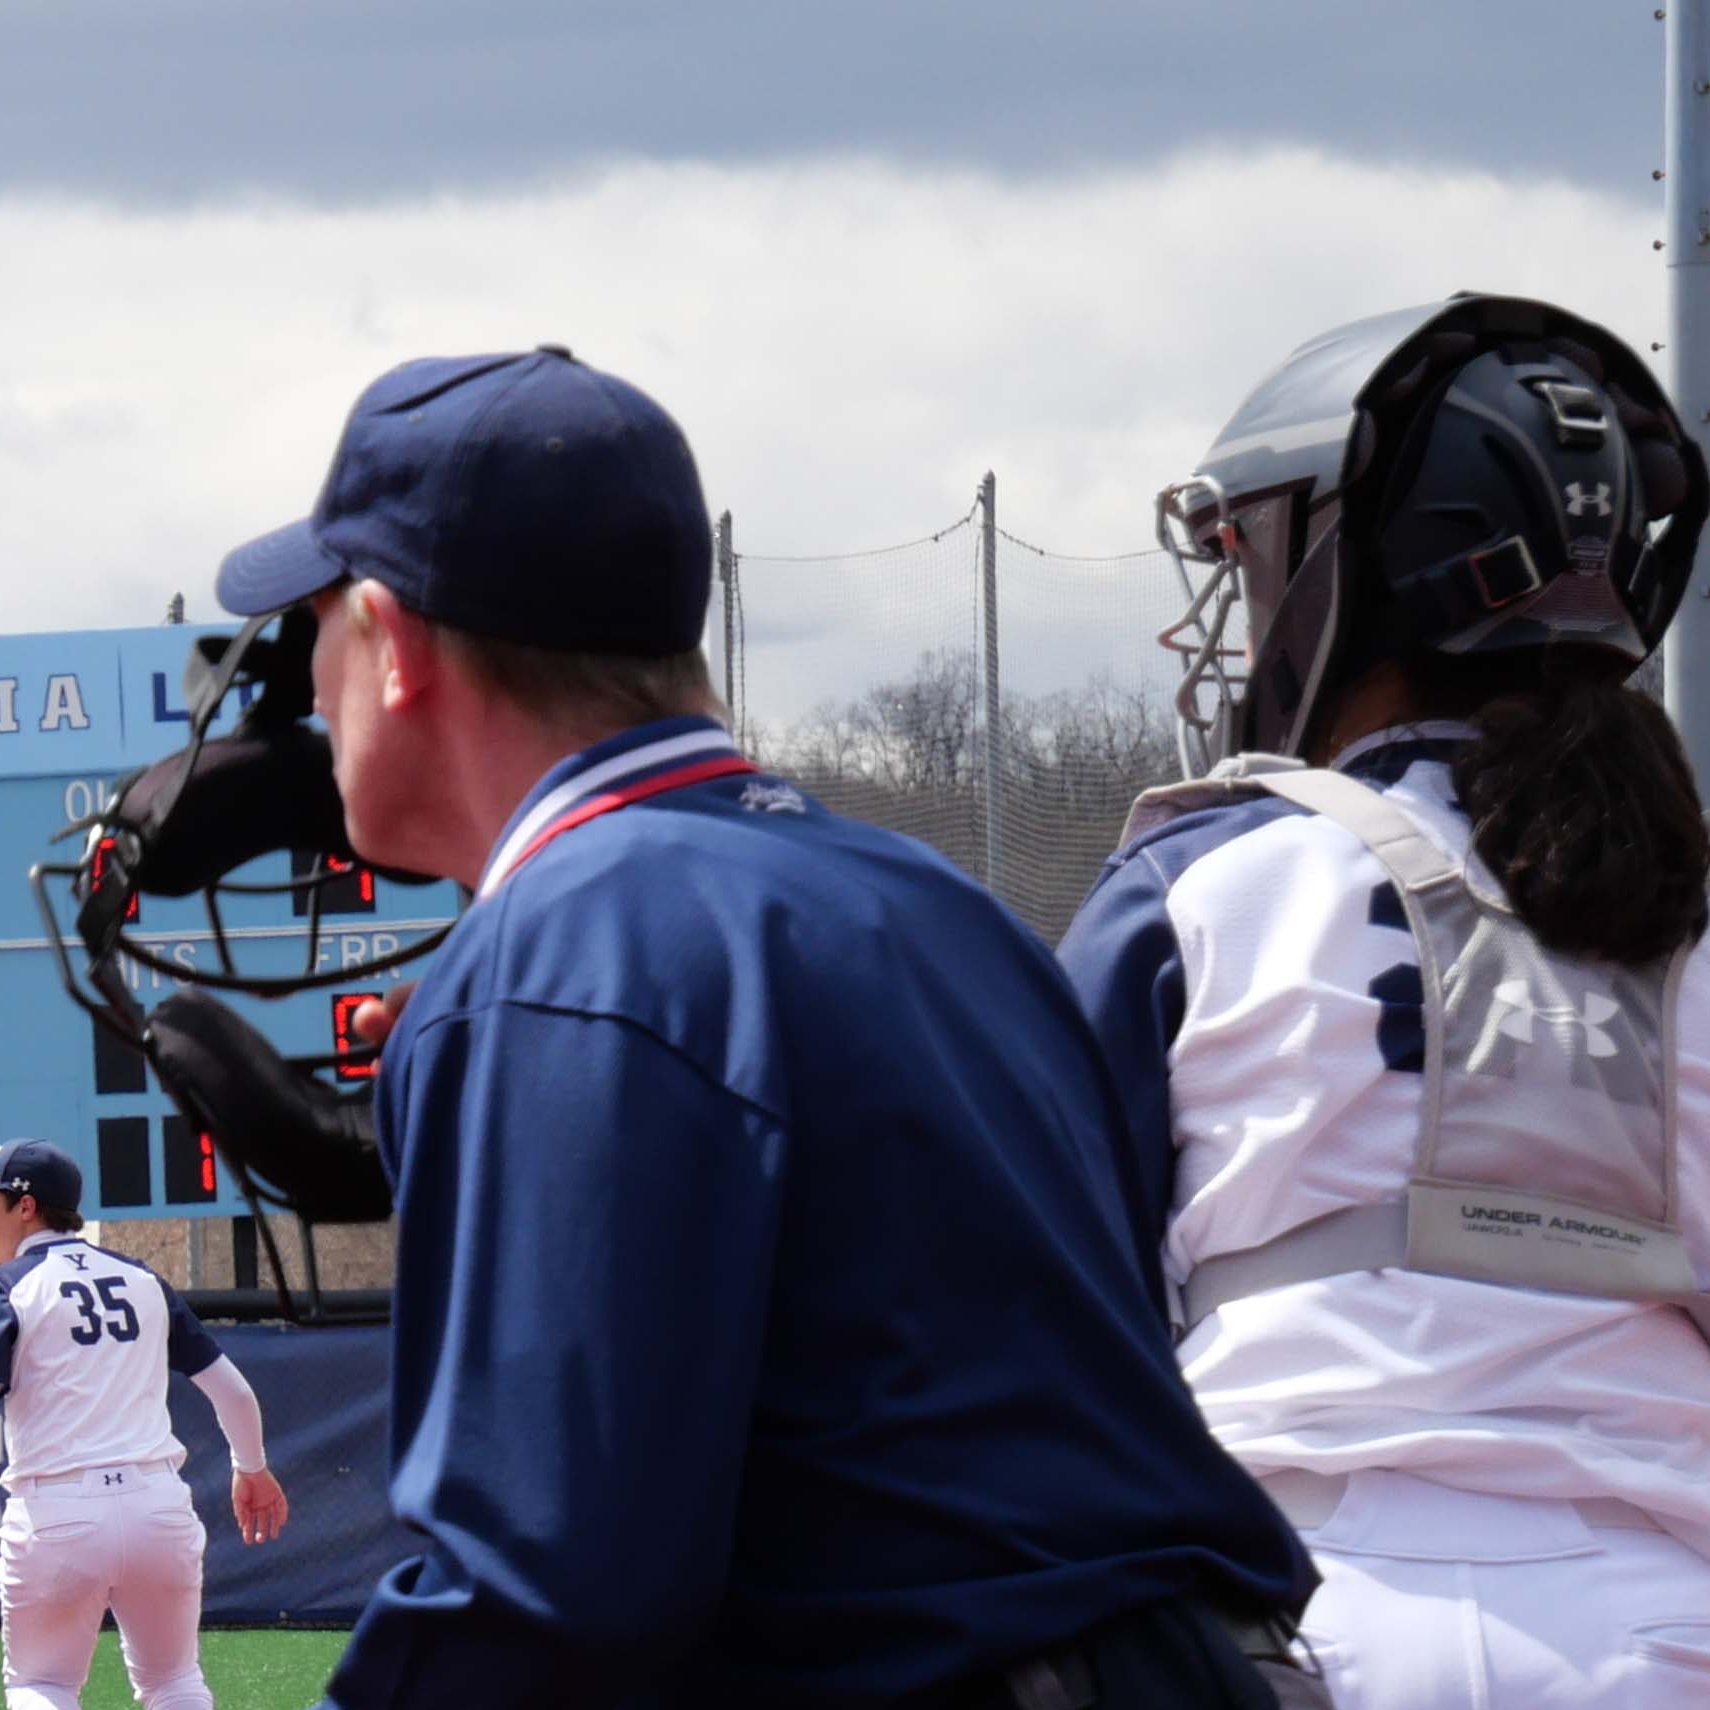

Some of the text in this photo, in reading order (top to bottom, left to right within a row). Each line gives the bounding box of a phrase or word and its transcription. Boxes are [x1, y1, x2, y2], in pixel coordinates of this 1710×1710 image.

[1461, 1204, 1541, 1227] UNDER
[1548, 1216, 1644, 1246] ARMOUR
[63, 1253, 89, 1270] Y
[59, 1276, 140, 1345] 35
